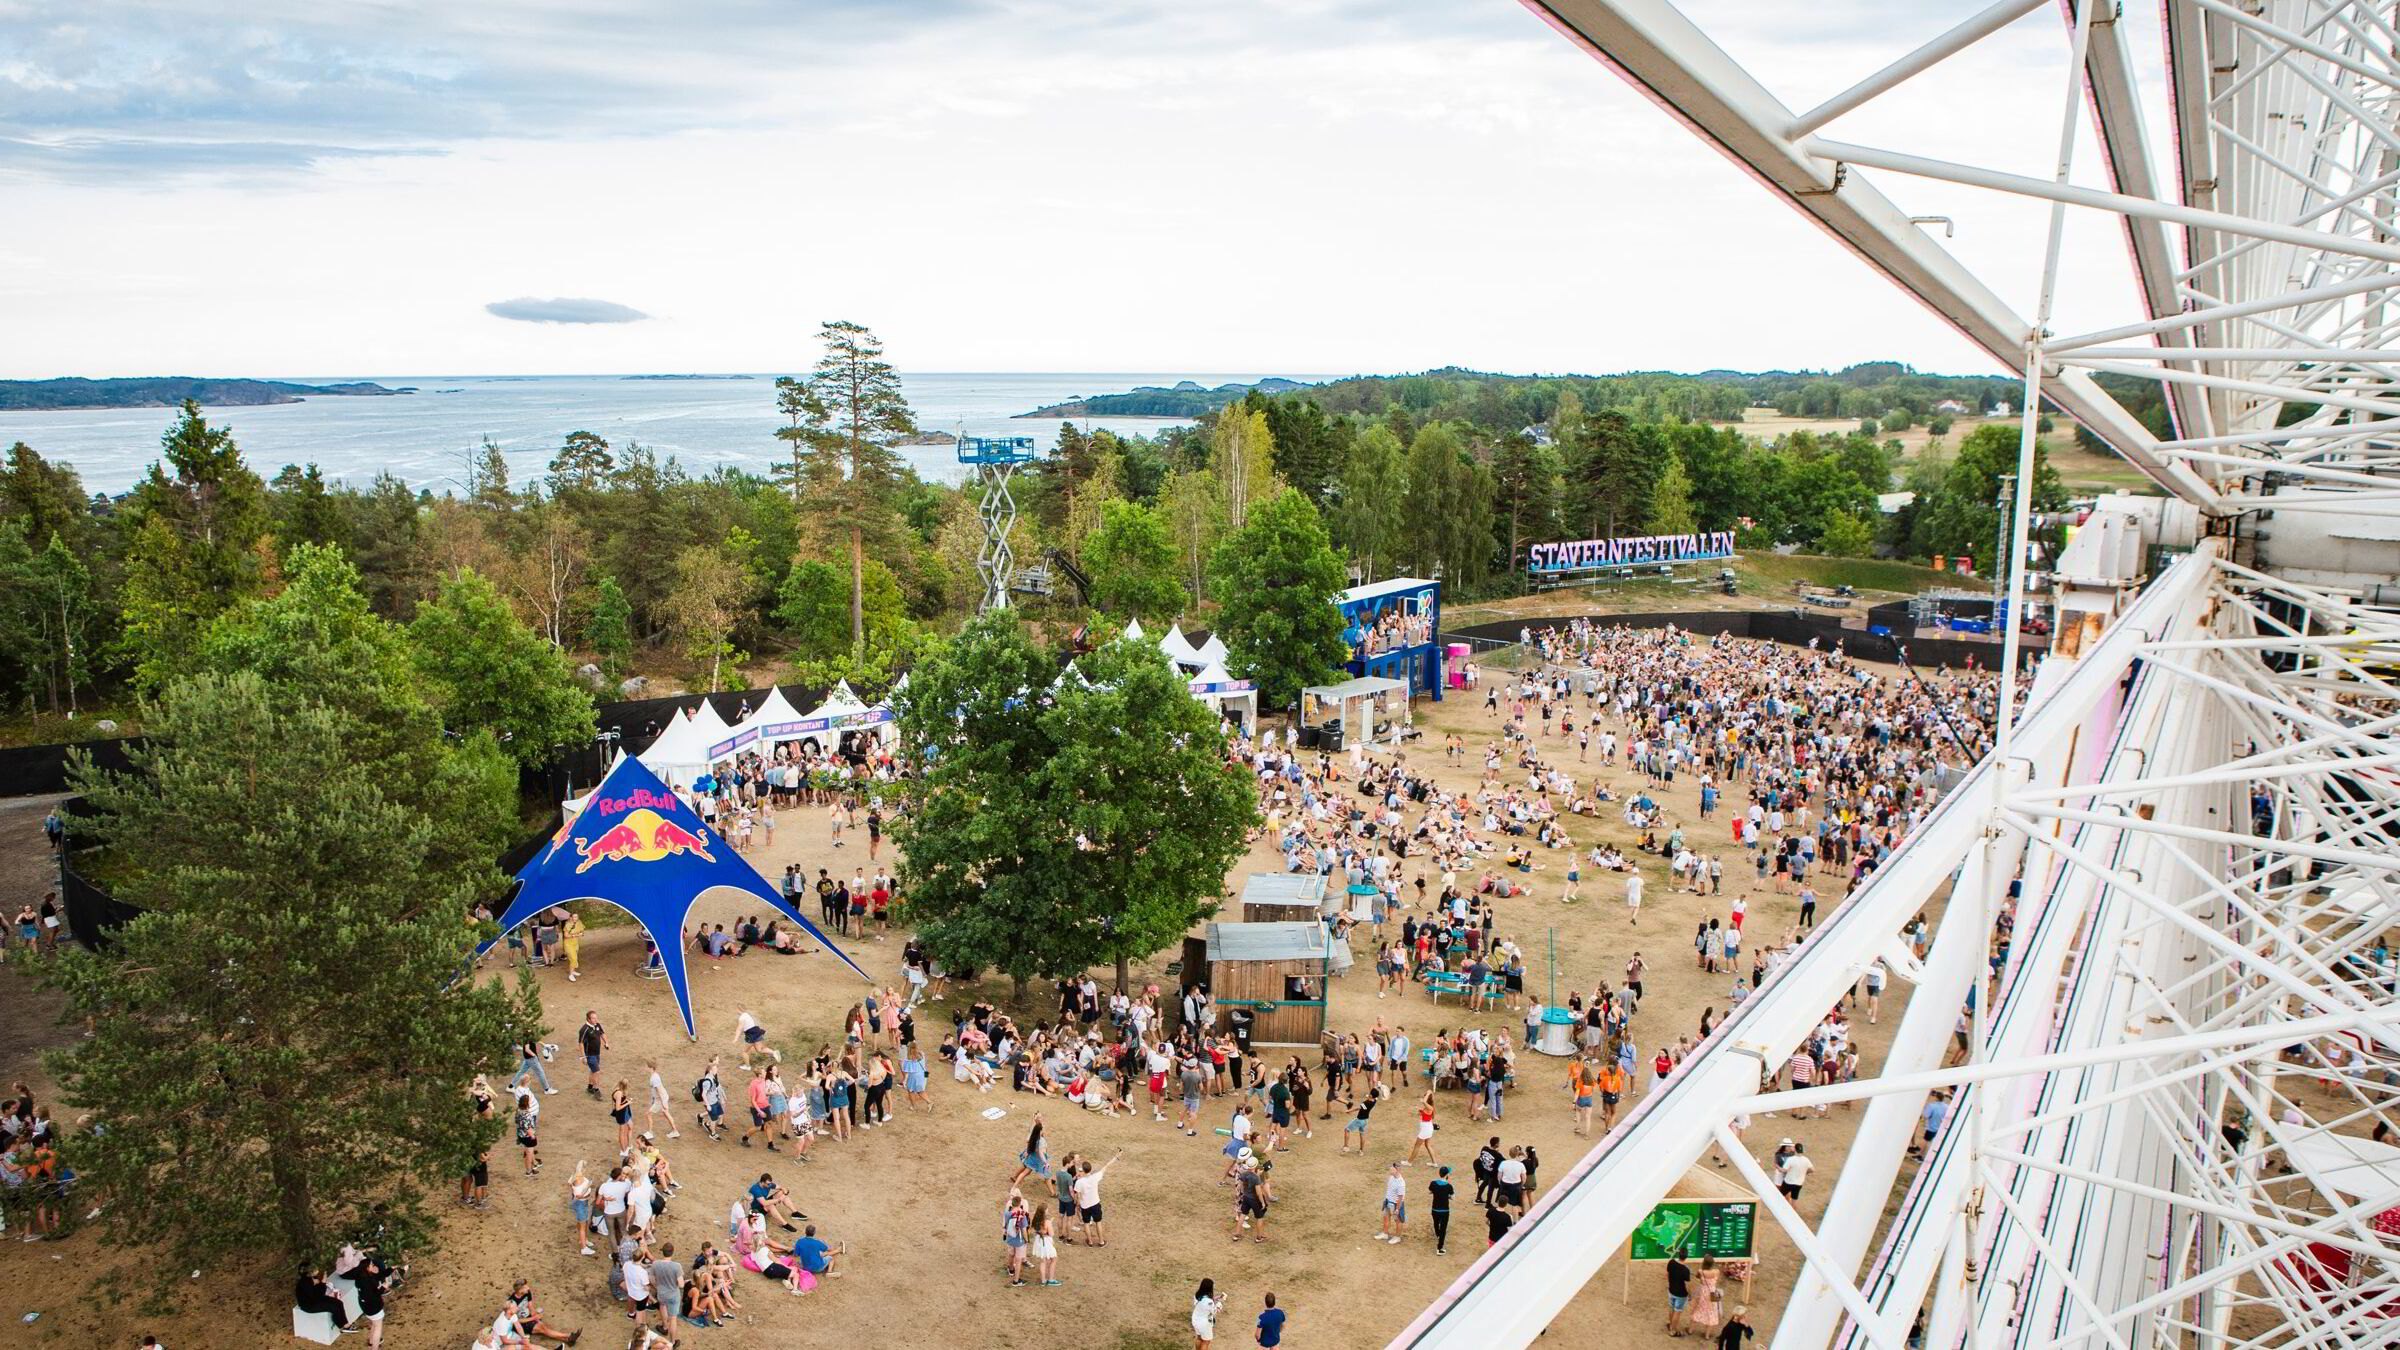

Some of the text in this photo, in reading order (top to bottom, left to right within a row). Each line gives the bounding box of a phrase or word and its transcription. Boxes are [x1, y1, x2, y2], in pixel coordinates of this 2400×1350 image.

[1528, 531, 1735, 571] STAVERNFESTIVALEN
[1225, 681, 1240, 691] TOP
[868, 712, 881, 723] UP
[767, 726, 781, 735] TOP
[782, 724, 793, 733] UP
